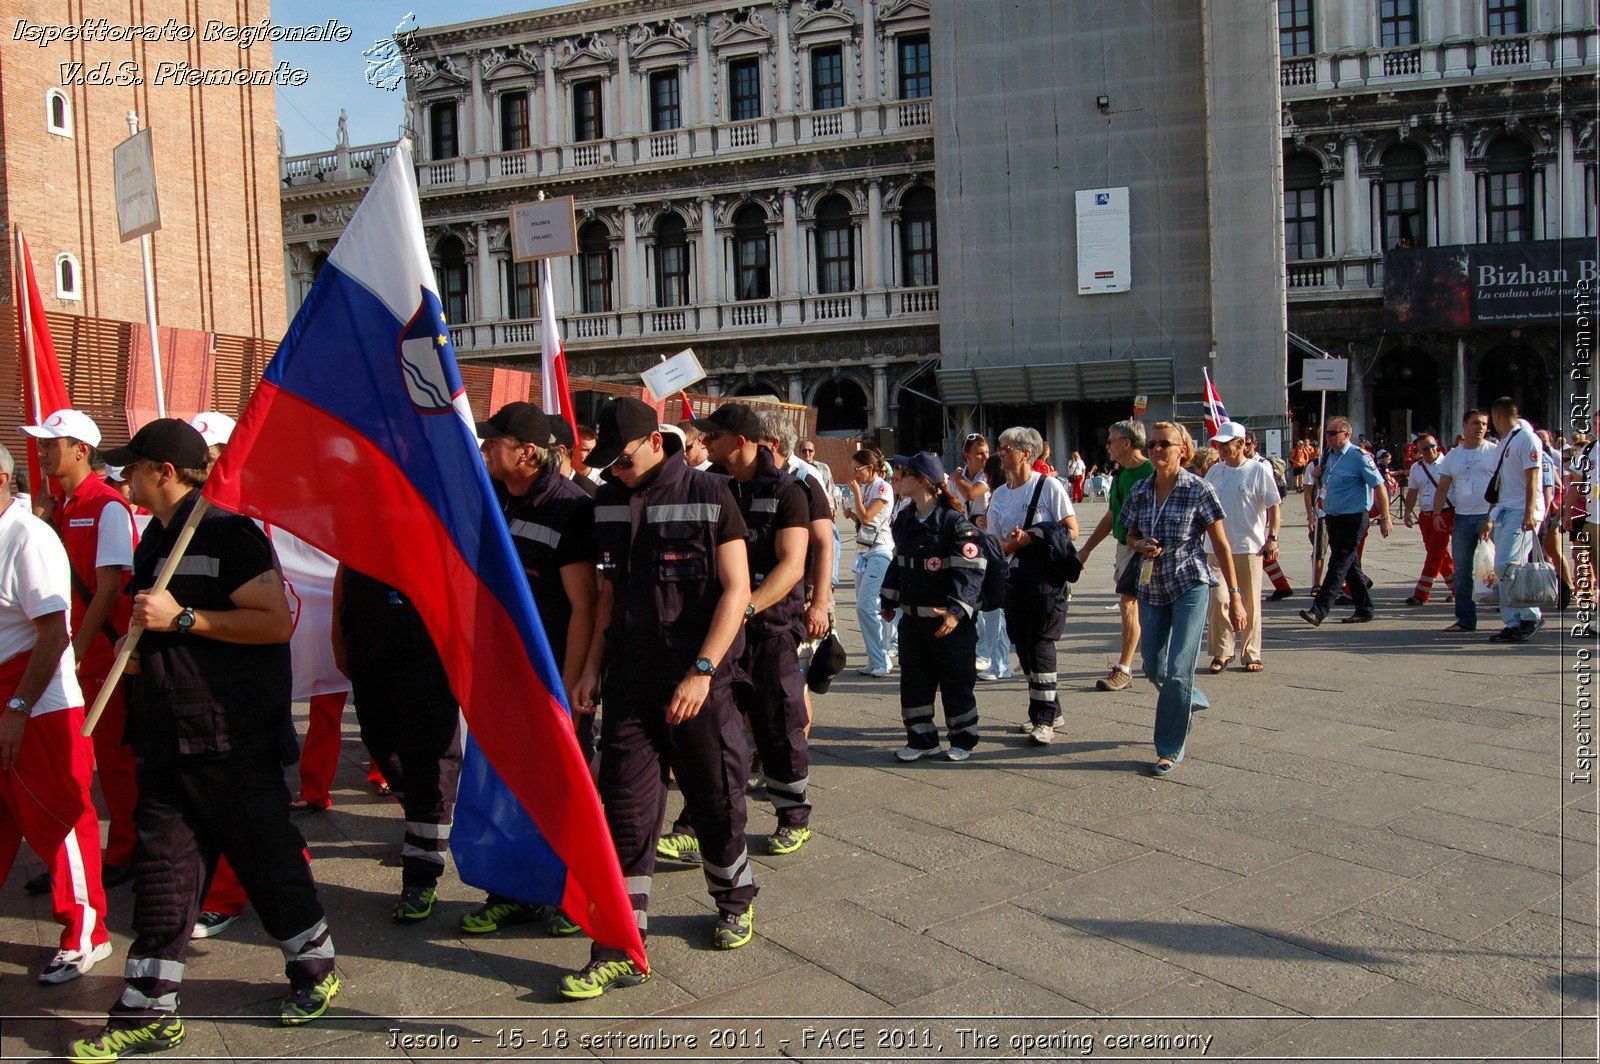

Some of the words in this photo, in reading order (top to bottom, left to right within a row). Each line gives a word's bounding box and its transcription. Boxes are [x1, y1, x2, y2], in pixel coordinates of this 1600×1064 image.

[530, 219, 551, 227] POLONIA
[1476, 263, 1569, 287] Bizhan
[1577, 259, 1600, 281] B
[1477, 290, 1491, 300] La
[1493, 288, 1530, 300] caduta
[1531, 286, 1557, 297] delle
